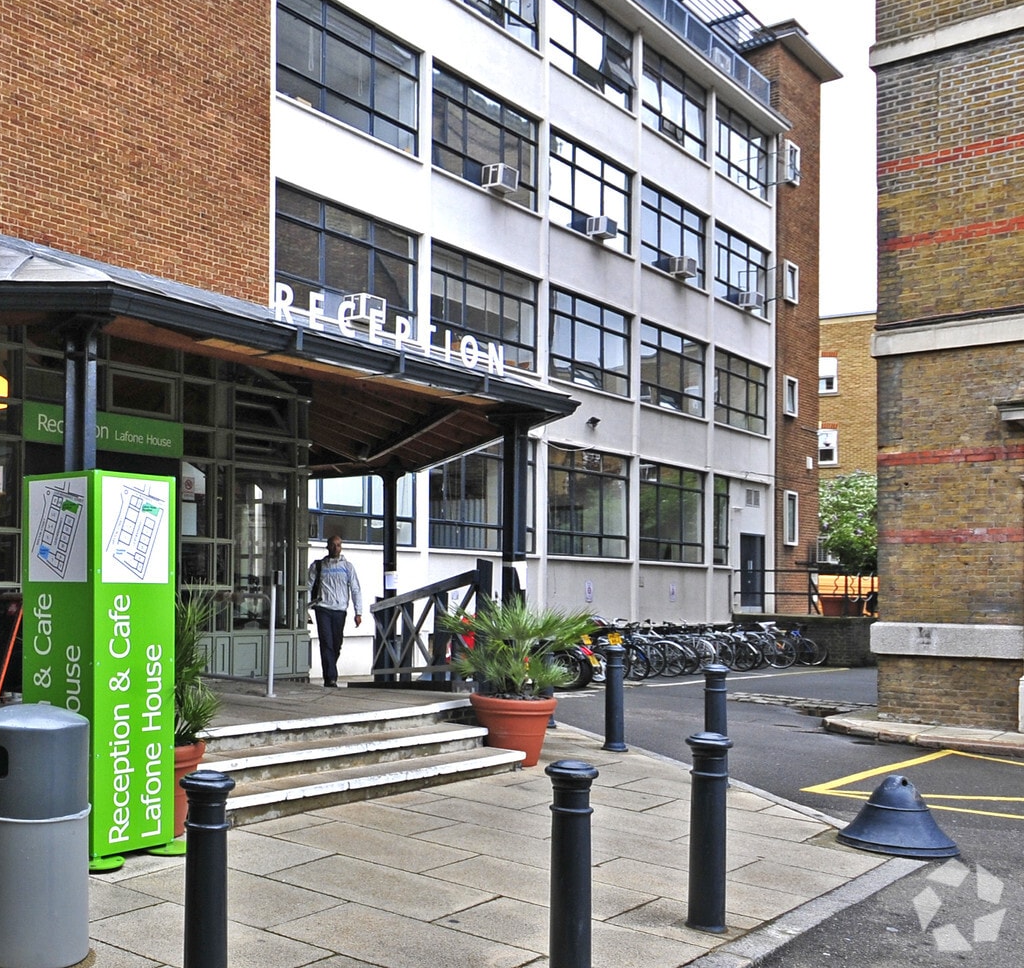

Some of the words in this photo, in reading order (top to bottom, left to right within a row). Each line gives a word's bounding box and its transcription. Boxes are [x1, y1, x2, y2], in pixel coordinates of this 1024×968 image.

[275, 282, 504, 377] RECEPTION
[114, 430, 143, 444] Lafone
[147, 435, 172, 448] House
[33, 593, 52, 656] Cafe
[108, 593, 131, 659] Cafe
[33, 666, 52, 689] &
[66, 644, 81, 713] ouse
[109, 667, 131, 692] &
[142, 644, 162, 732] House
[109, 703, 135, 844] Reception
[141, 742, 162, 838] Lafone
